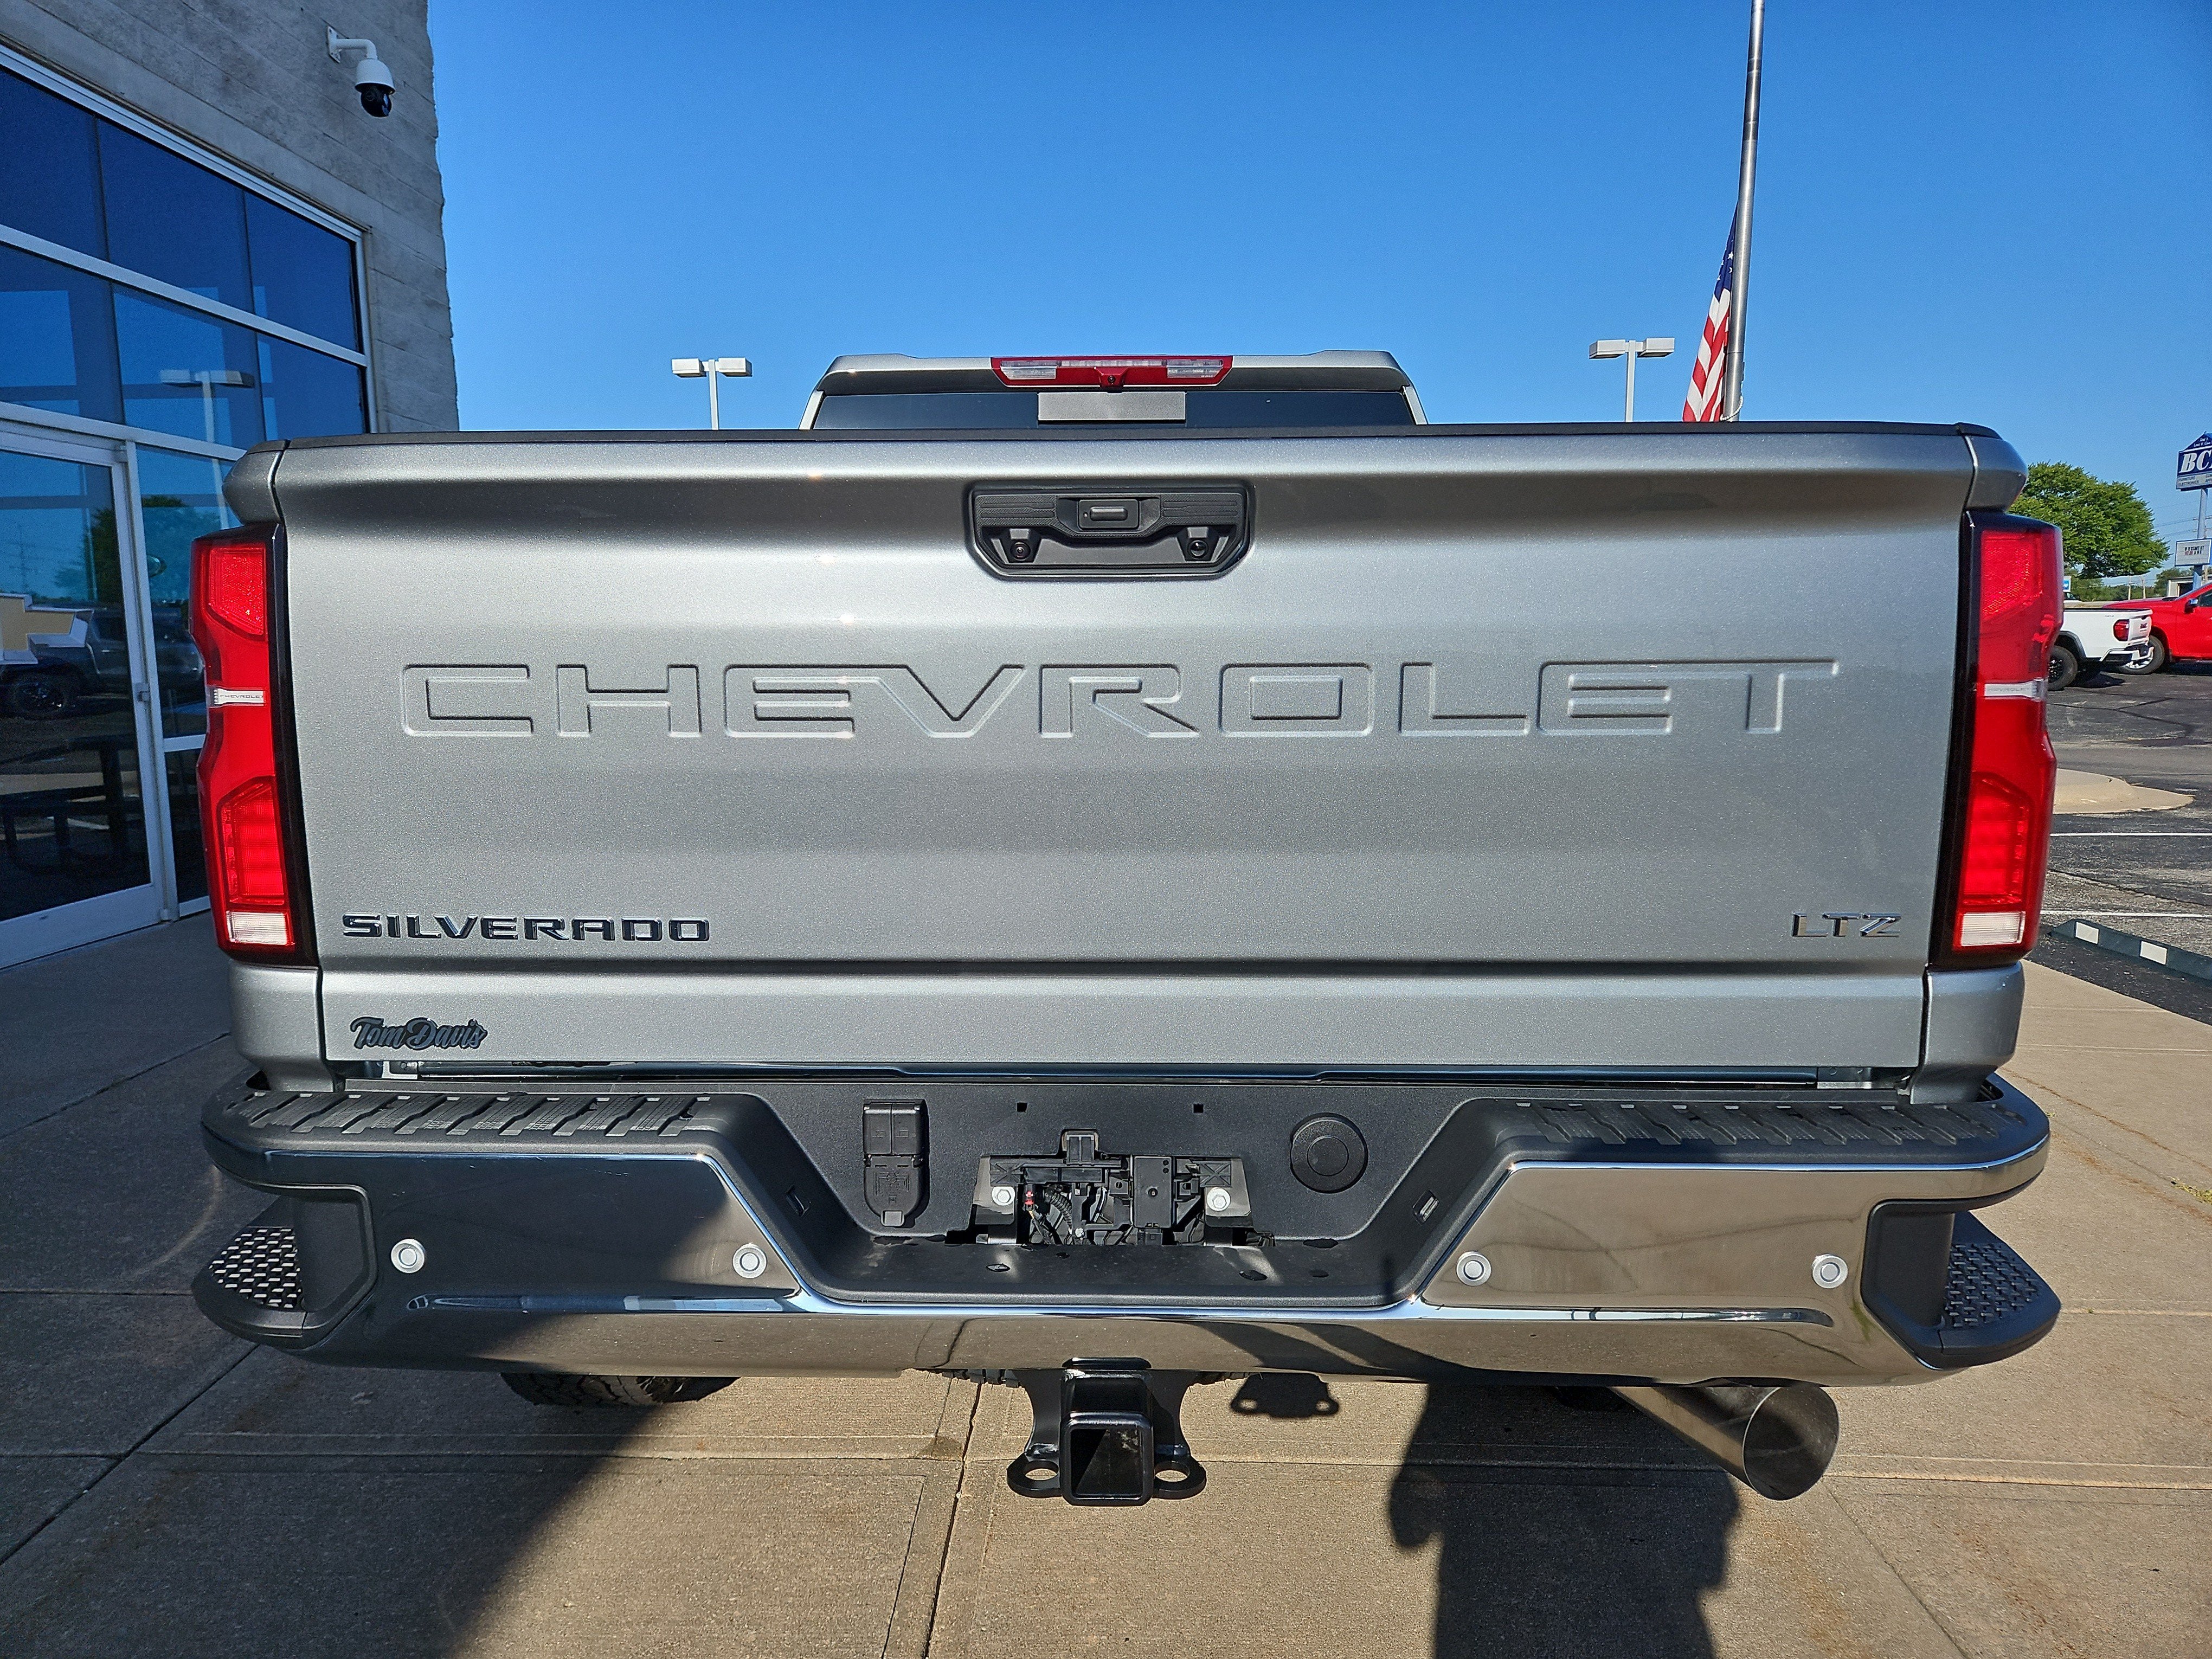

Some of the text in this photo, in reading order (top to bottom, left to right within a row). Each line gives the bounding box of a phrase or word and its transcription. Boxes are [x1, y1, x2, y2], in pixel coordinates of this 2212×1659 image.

[2179, 449, 2212, 473] BC
[403, 660, 1839, 738] CHEVROLET
[342, 913, 710, 941] SILVERADO
[1792, 912, 1901, 937] LTZ
[350, 1017, 488, 1050] Tom Davis
